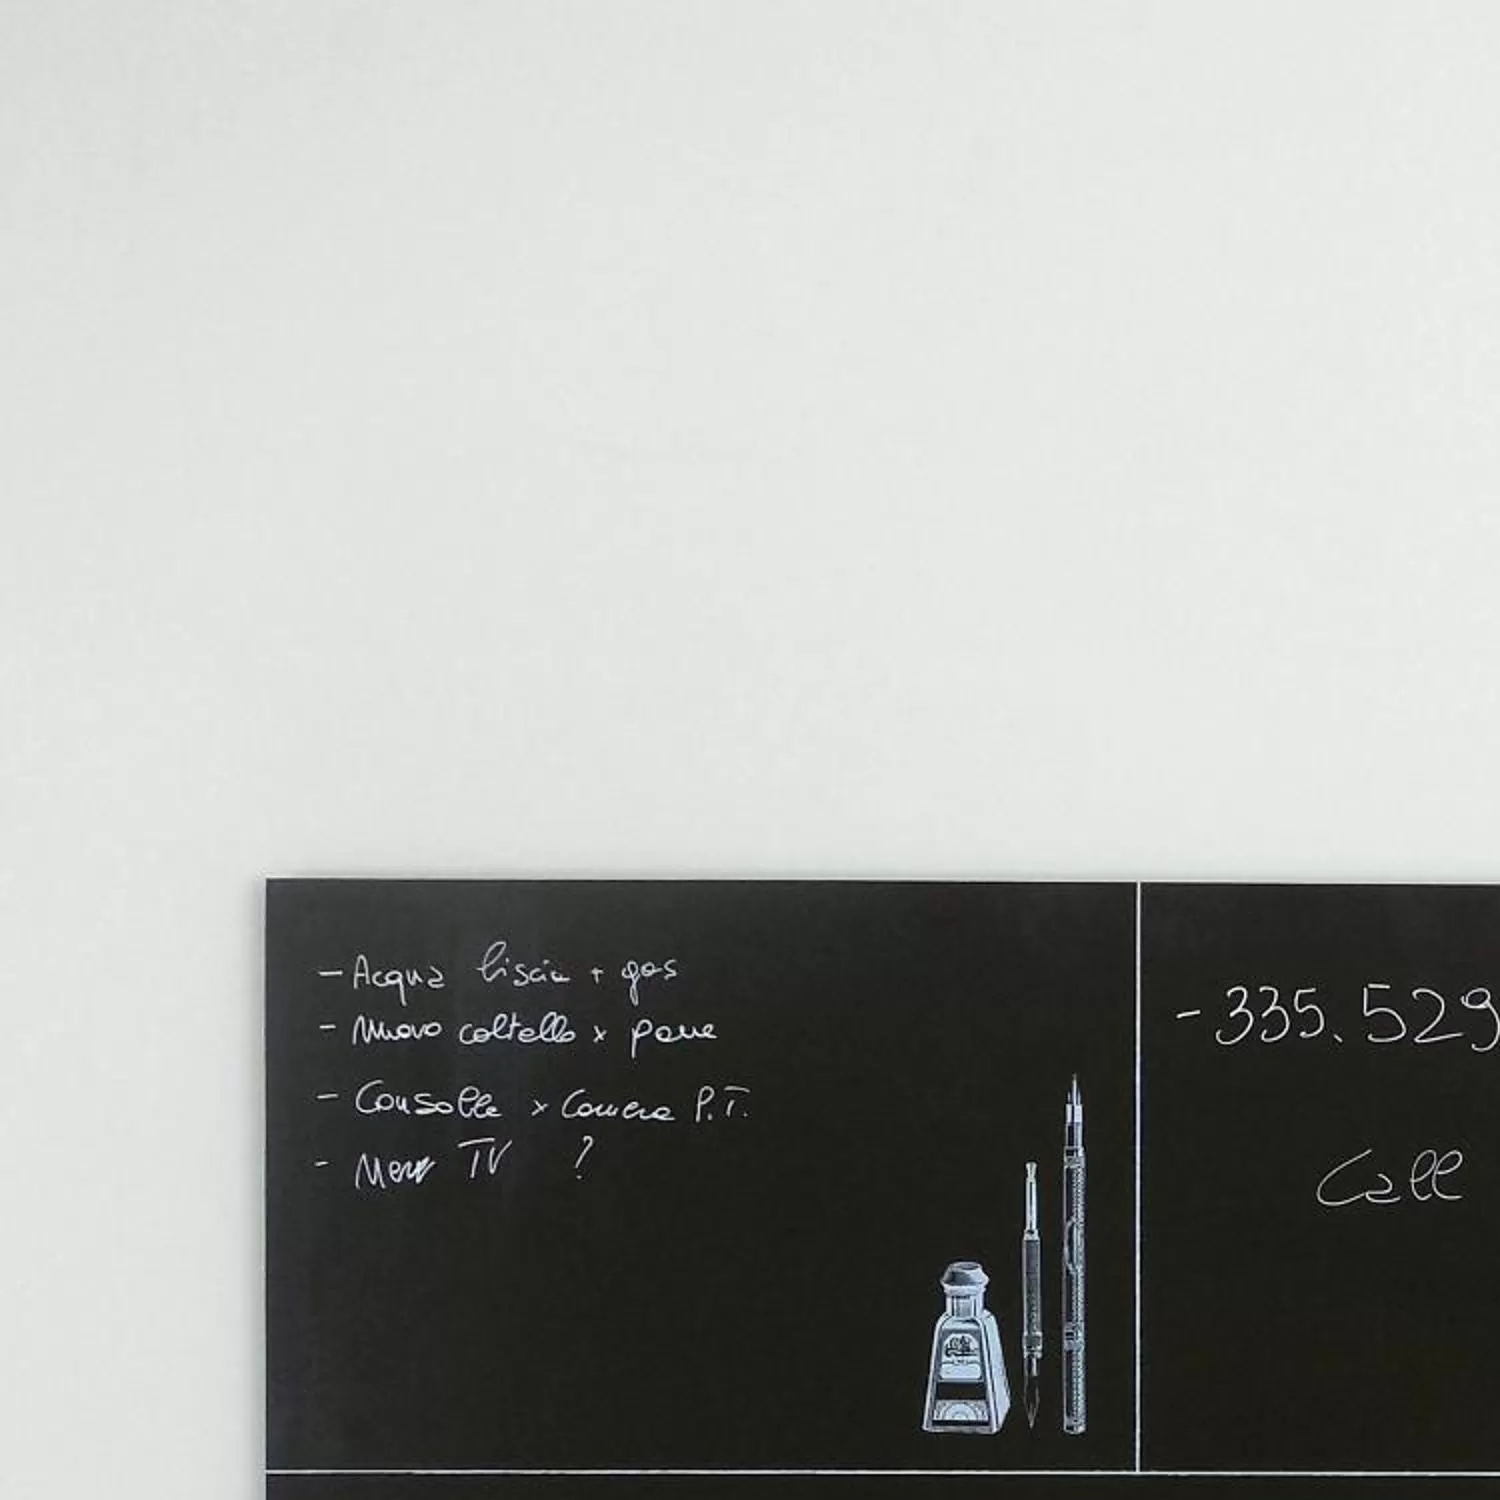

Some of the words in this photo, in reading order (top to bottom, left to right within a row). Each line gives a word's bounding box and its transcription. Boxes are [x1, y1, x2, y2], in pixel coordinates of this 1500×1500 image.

[620, 958, 680, 1006] gas
[458, 1010, 577, 1045] coltello
[457, 1136, 513, 1180] TV
